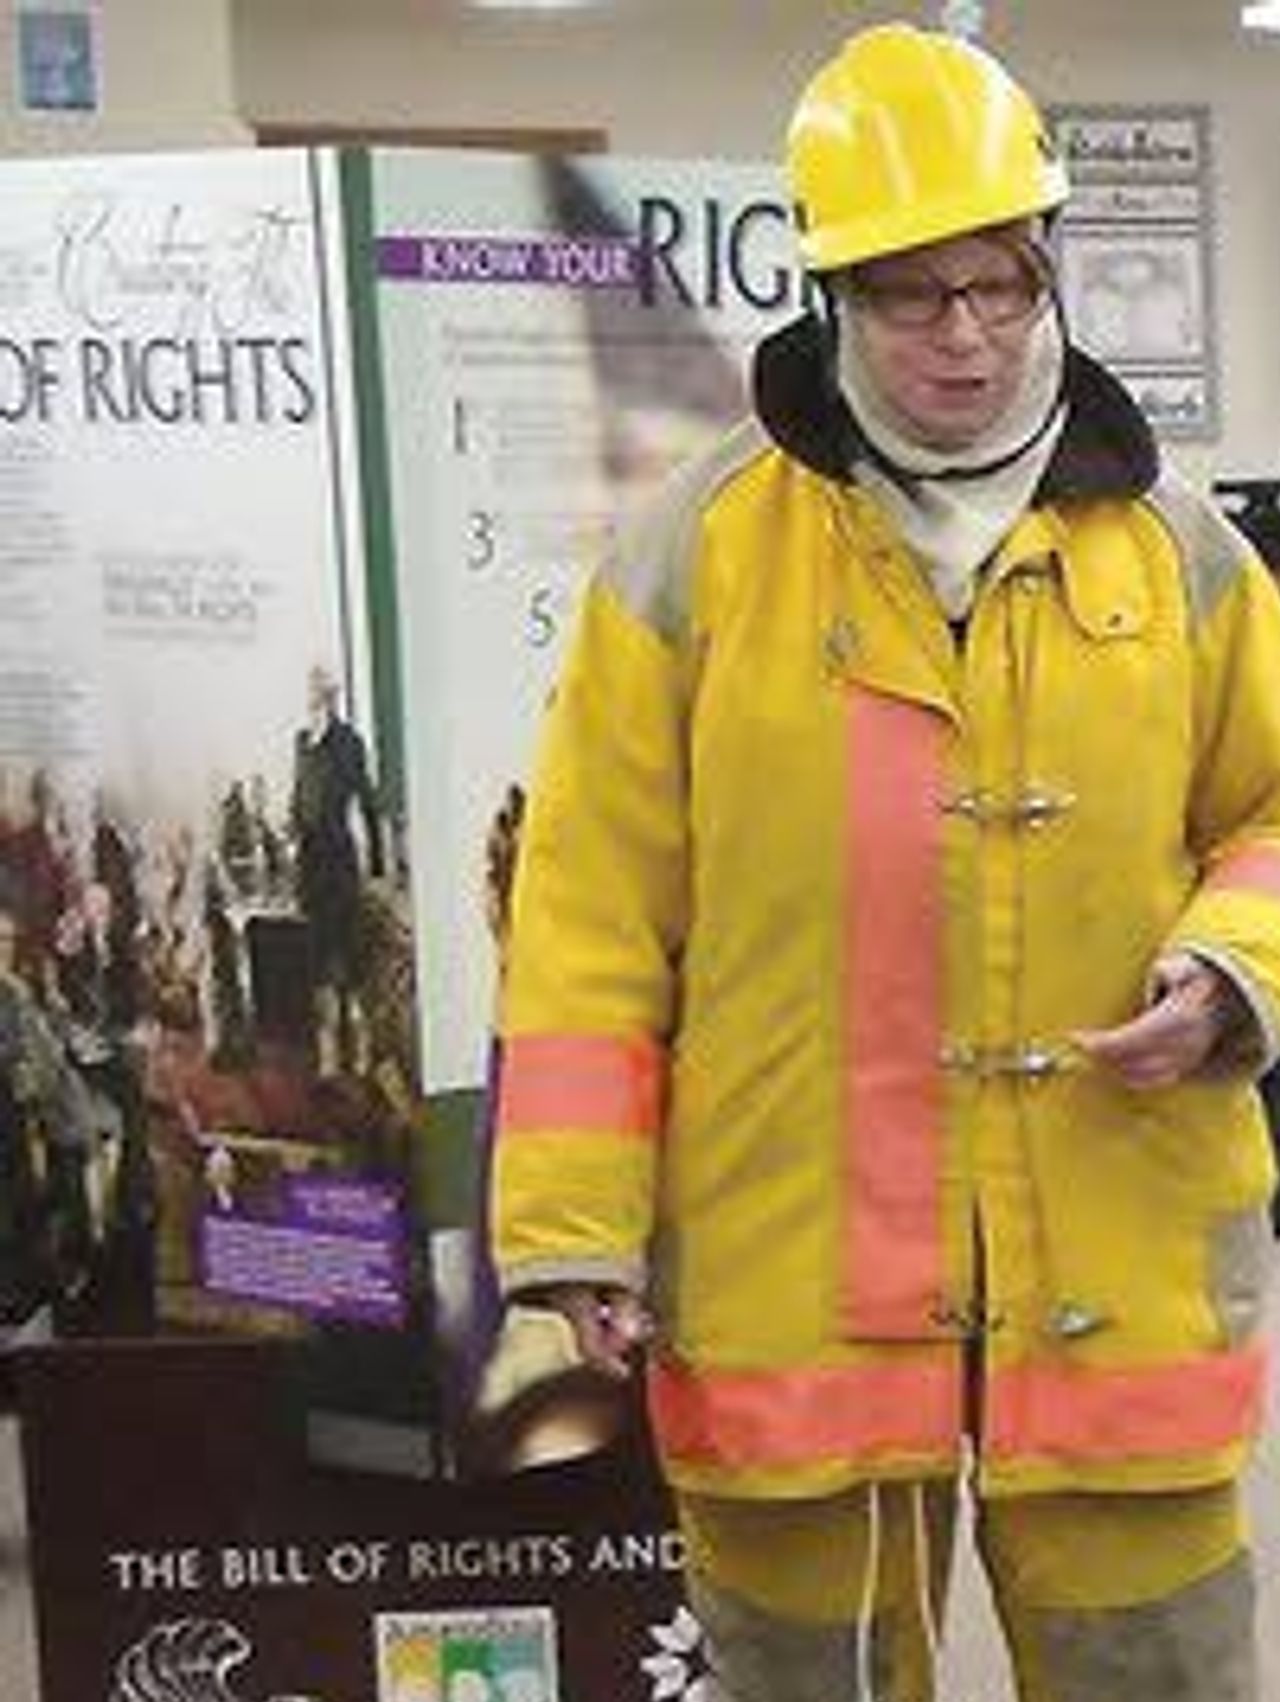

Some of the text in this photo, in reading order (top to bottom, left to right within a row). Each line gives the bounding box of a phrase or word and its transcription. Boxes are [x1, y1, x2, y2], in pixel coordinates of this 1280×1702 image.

[422, 244, 531, 276] KNOW
[546, 245, 632, 281] YOUR
[0, 337, 316, 424] OF RIGHTS
[465, 512, 494, 570] 3
[526, 588, 556, 648] 5
[110, 1534, 687, 1590] THE BILL OF RIGHTS AND
